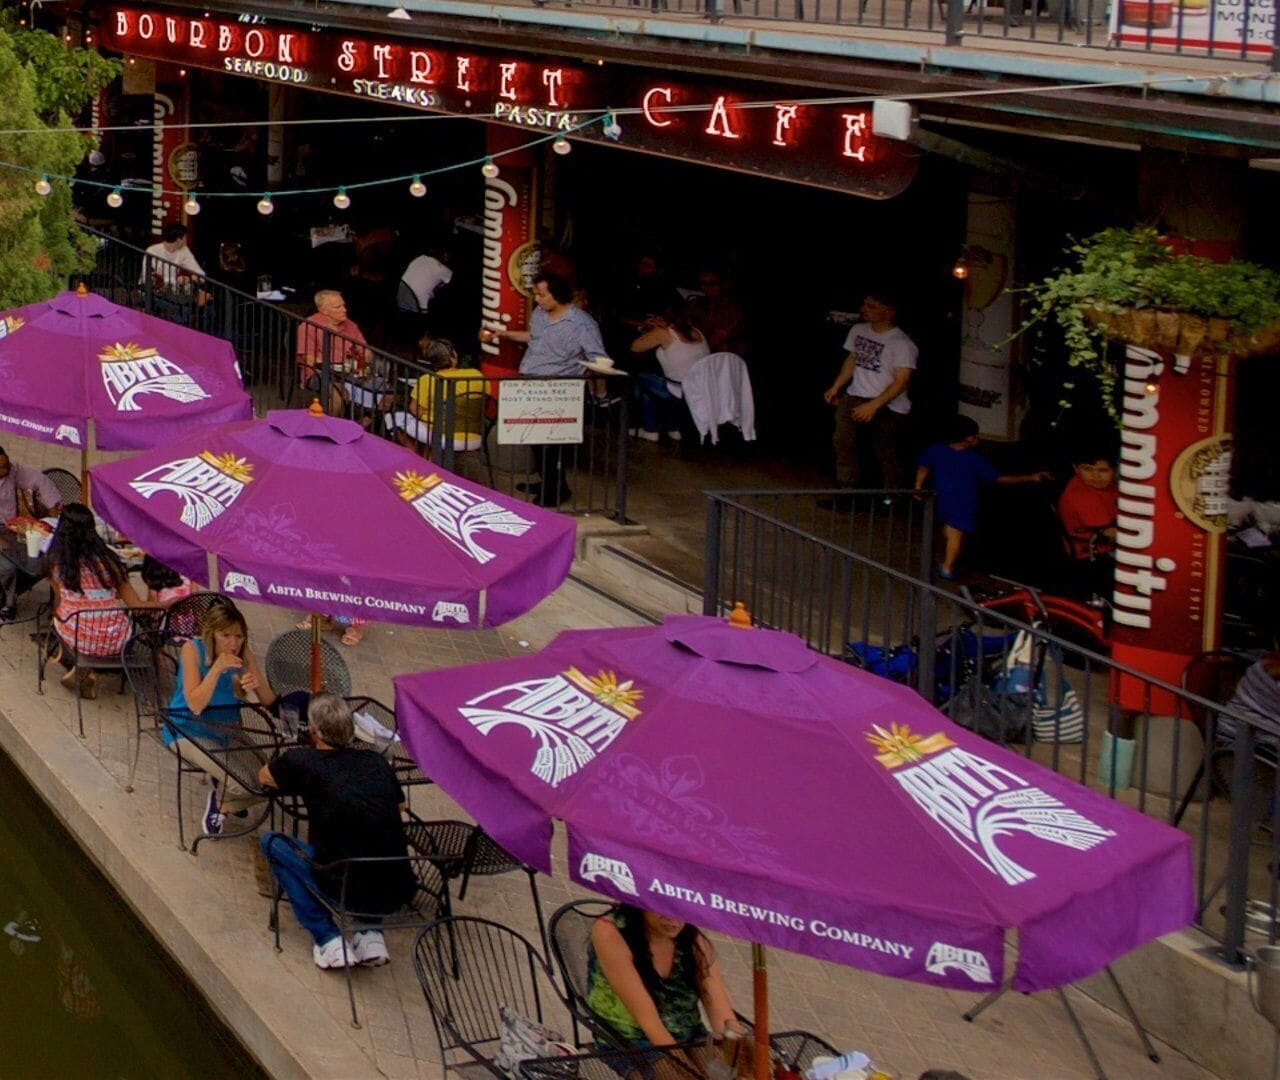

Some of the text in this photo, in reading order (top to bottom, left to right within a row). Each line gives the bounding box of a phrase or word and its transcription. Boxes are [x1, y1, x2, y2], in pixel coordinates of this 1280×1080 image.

[115, 11, 866, 162] BOURBON STREET CAFE
[224, 56, 572, 132] SEAFOOD STEAKS PASTA
[101, 355, 185, 402] ABITA
[1197, 389, 1211, 433] OWNED
[21, 420, 55, 435] COMPANY
[133, 455, 245, 509] ABITA
[411, 481, 486, 552] ABITA
[1112, 344, 1190, 624] ommunity
[267, 582, 426, 616] ABITA BREWING COMPANY
[1189, 532, 1204, 621] SINCE 1919
[464, 674, 628, 754] ABITA
[892, 747, 1029, 855] ABITA
[582, 852, 633, 879] ABITA
[648, 877, 913, 960] ABITA BREWING COMPANY
[927, 941, 988, 967] ABITA
